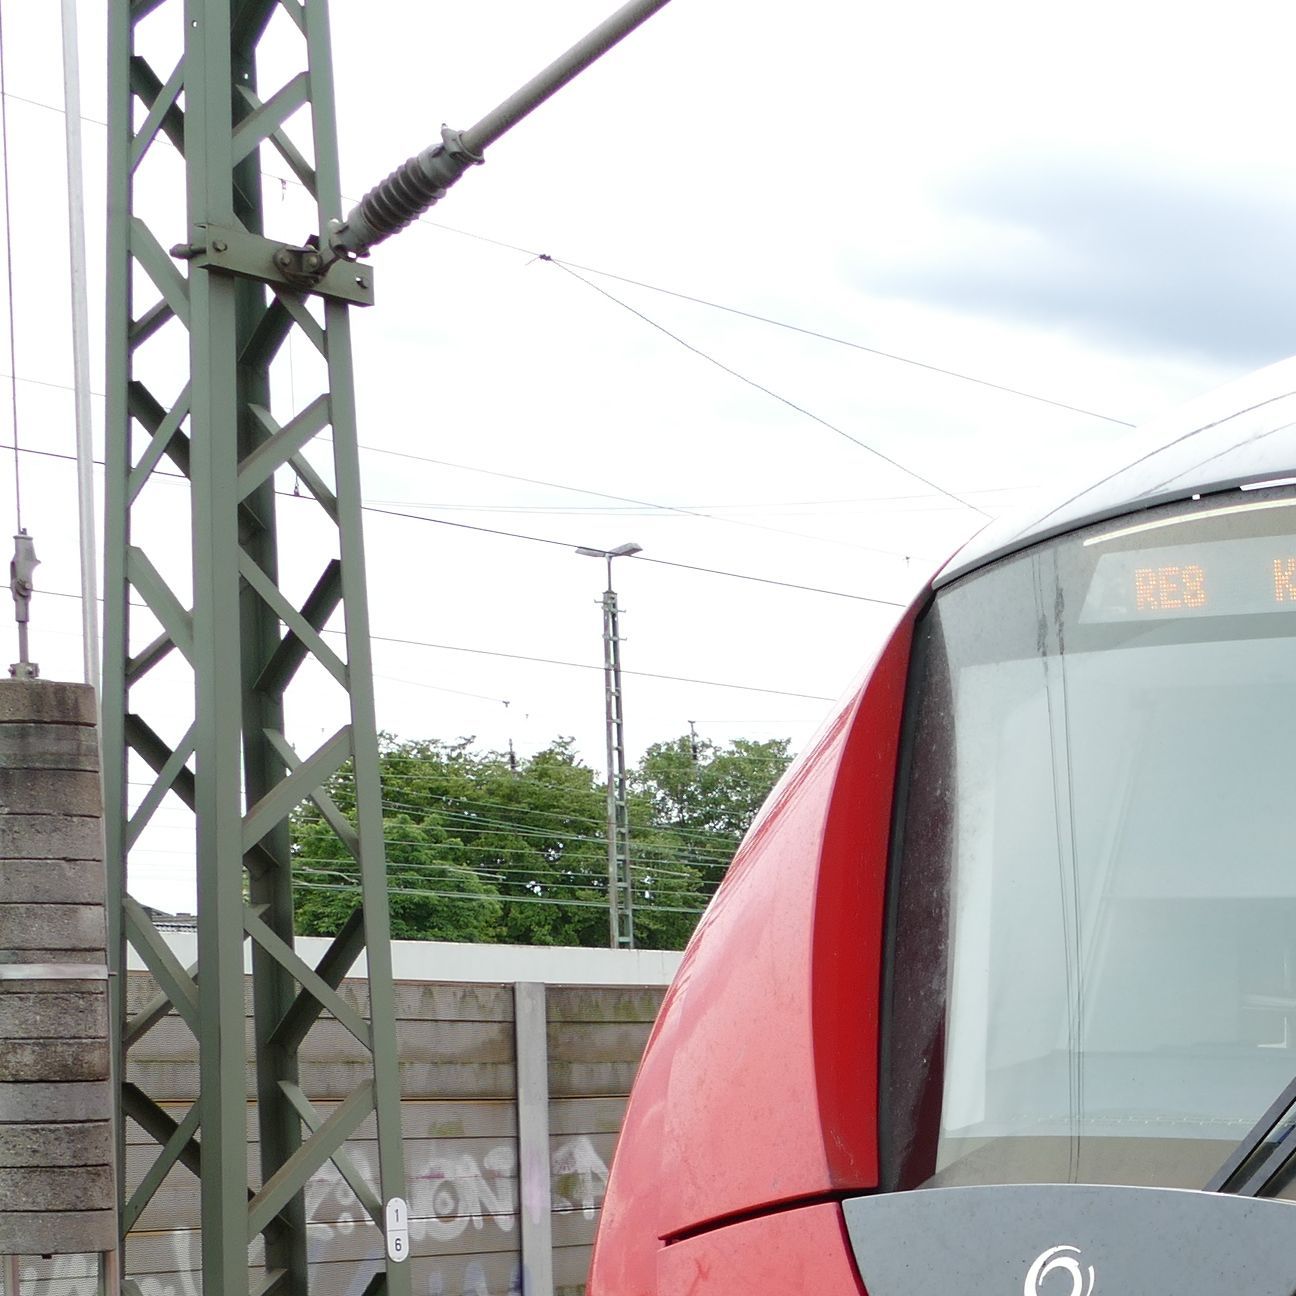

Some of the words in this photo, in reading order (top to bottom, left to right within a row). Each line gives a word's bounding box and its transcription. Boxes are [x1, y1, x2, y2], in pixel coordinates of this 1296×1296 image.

[1134, 563, 1206, 610] RE8
[395, 1208, 400, 1222] 1
[394, 1237, 402, 1252] 6
